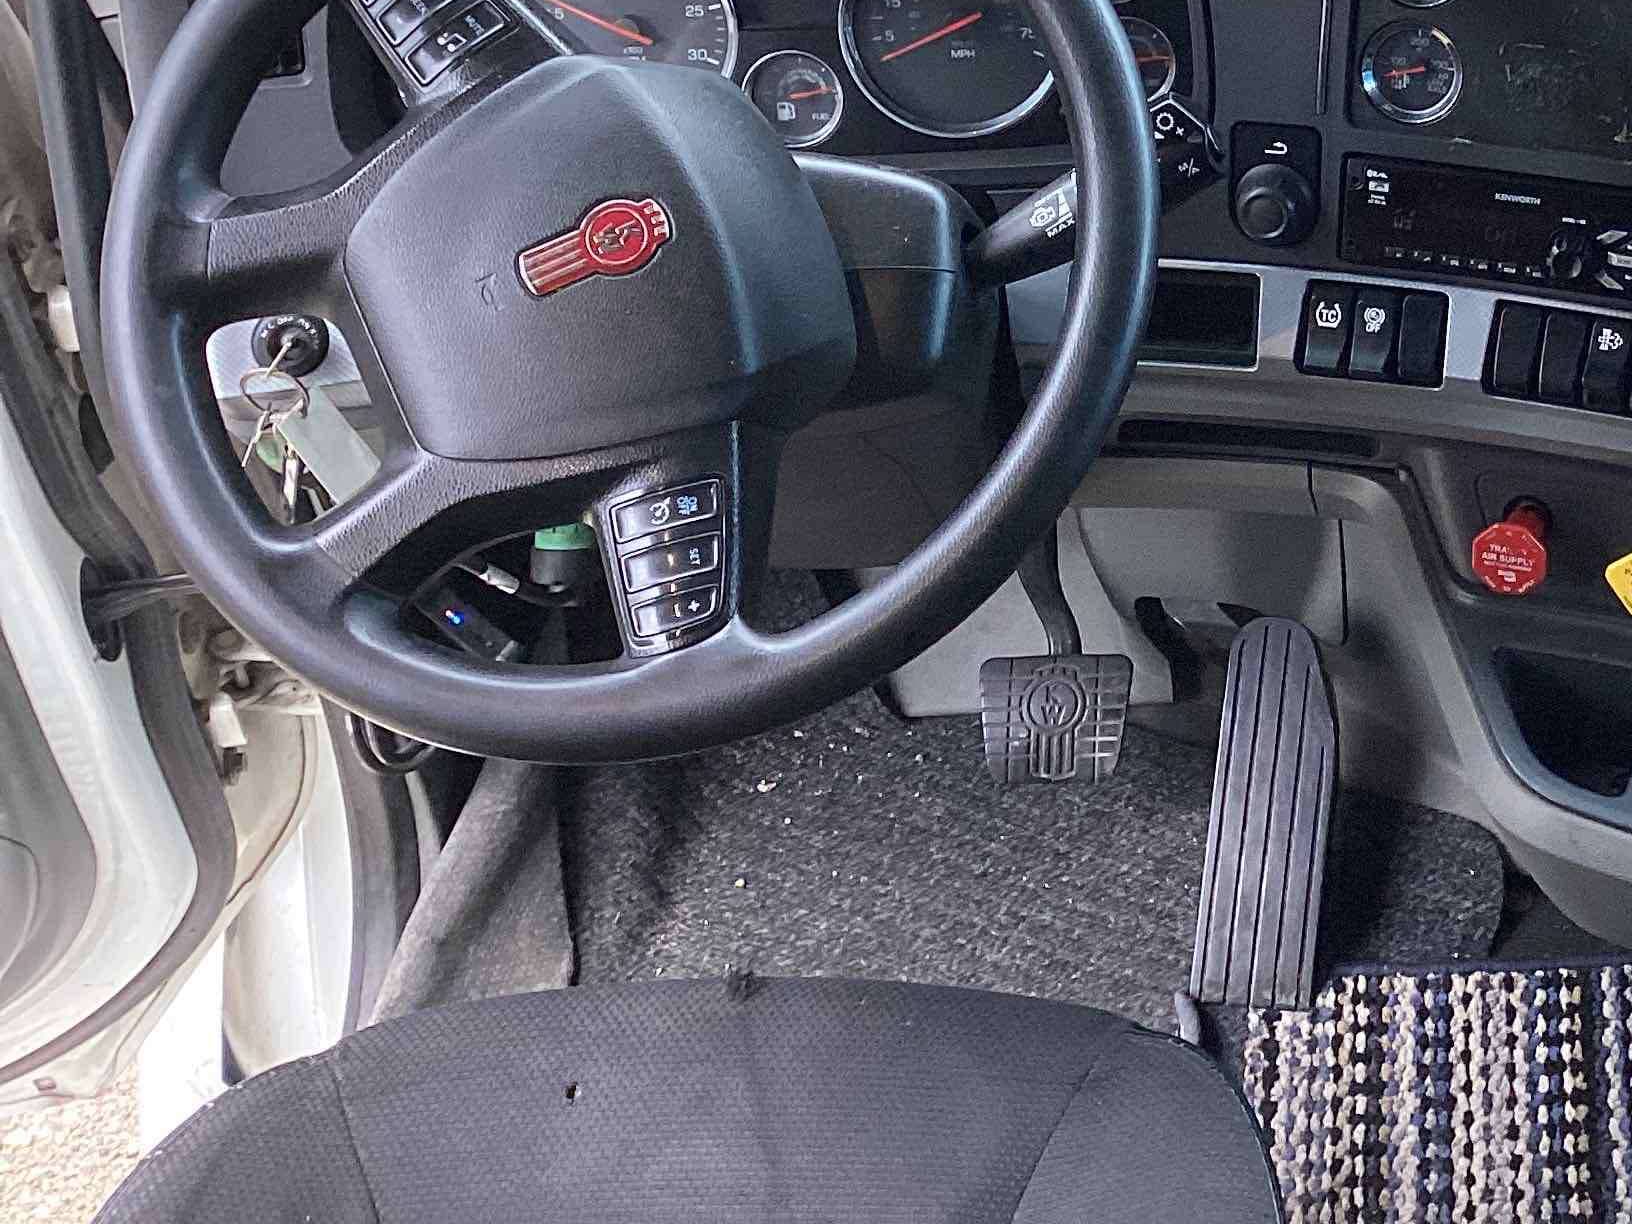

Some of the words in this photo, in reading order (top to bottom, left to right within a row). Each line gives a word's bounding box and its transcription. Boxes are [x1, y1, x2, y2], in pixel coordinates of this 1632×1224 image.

[554, 8, 565, 20] 5
[685, 5, 705, 17] 25
[465, 15, 485, 36] MUTE
[884, 30, 895, 42] 5
[687, 48, 707, 60] 30
[950, 49, 976, 59] MPH
[1494, 192, 1541, 205] KENWORTH
[1046, 217, 1076, 238] MAX
[1320, 309, 1337, 323] TC
[1366, 323, 1381, 333] OFF
[689, 547, 700, 565] SET
[1481, 551, 1497, 561] AIR
[1499, 554, 1535, 567] SUPPLY
